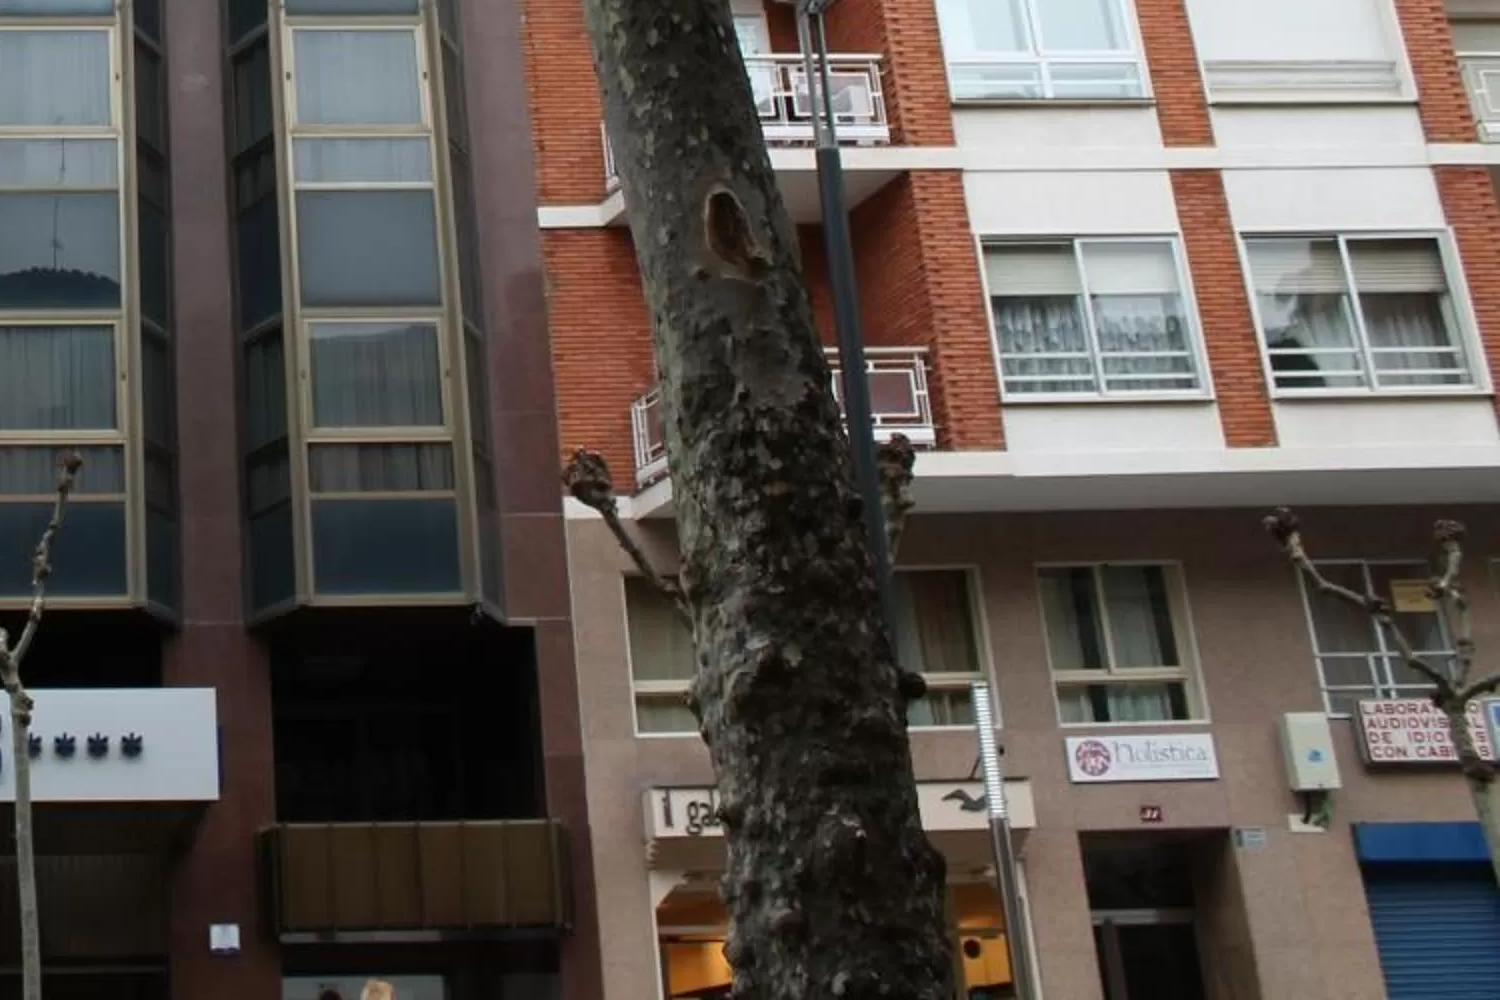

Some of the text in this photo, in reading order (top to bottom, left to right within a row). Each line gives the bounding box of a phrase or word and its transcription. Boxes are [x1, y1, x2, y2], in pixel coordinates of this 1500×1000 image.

[1363, 703, 1477, 715] LABORAO
[1367, 717, 1484, 729] AUDIOVISL
[1369, 731, 1485, 744] DE IDIOS
[1372, 745, 1490, 758] CON CABIS
